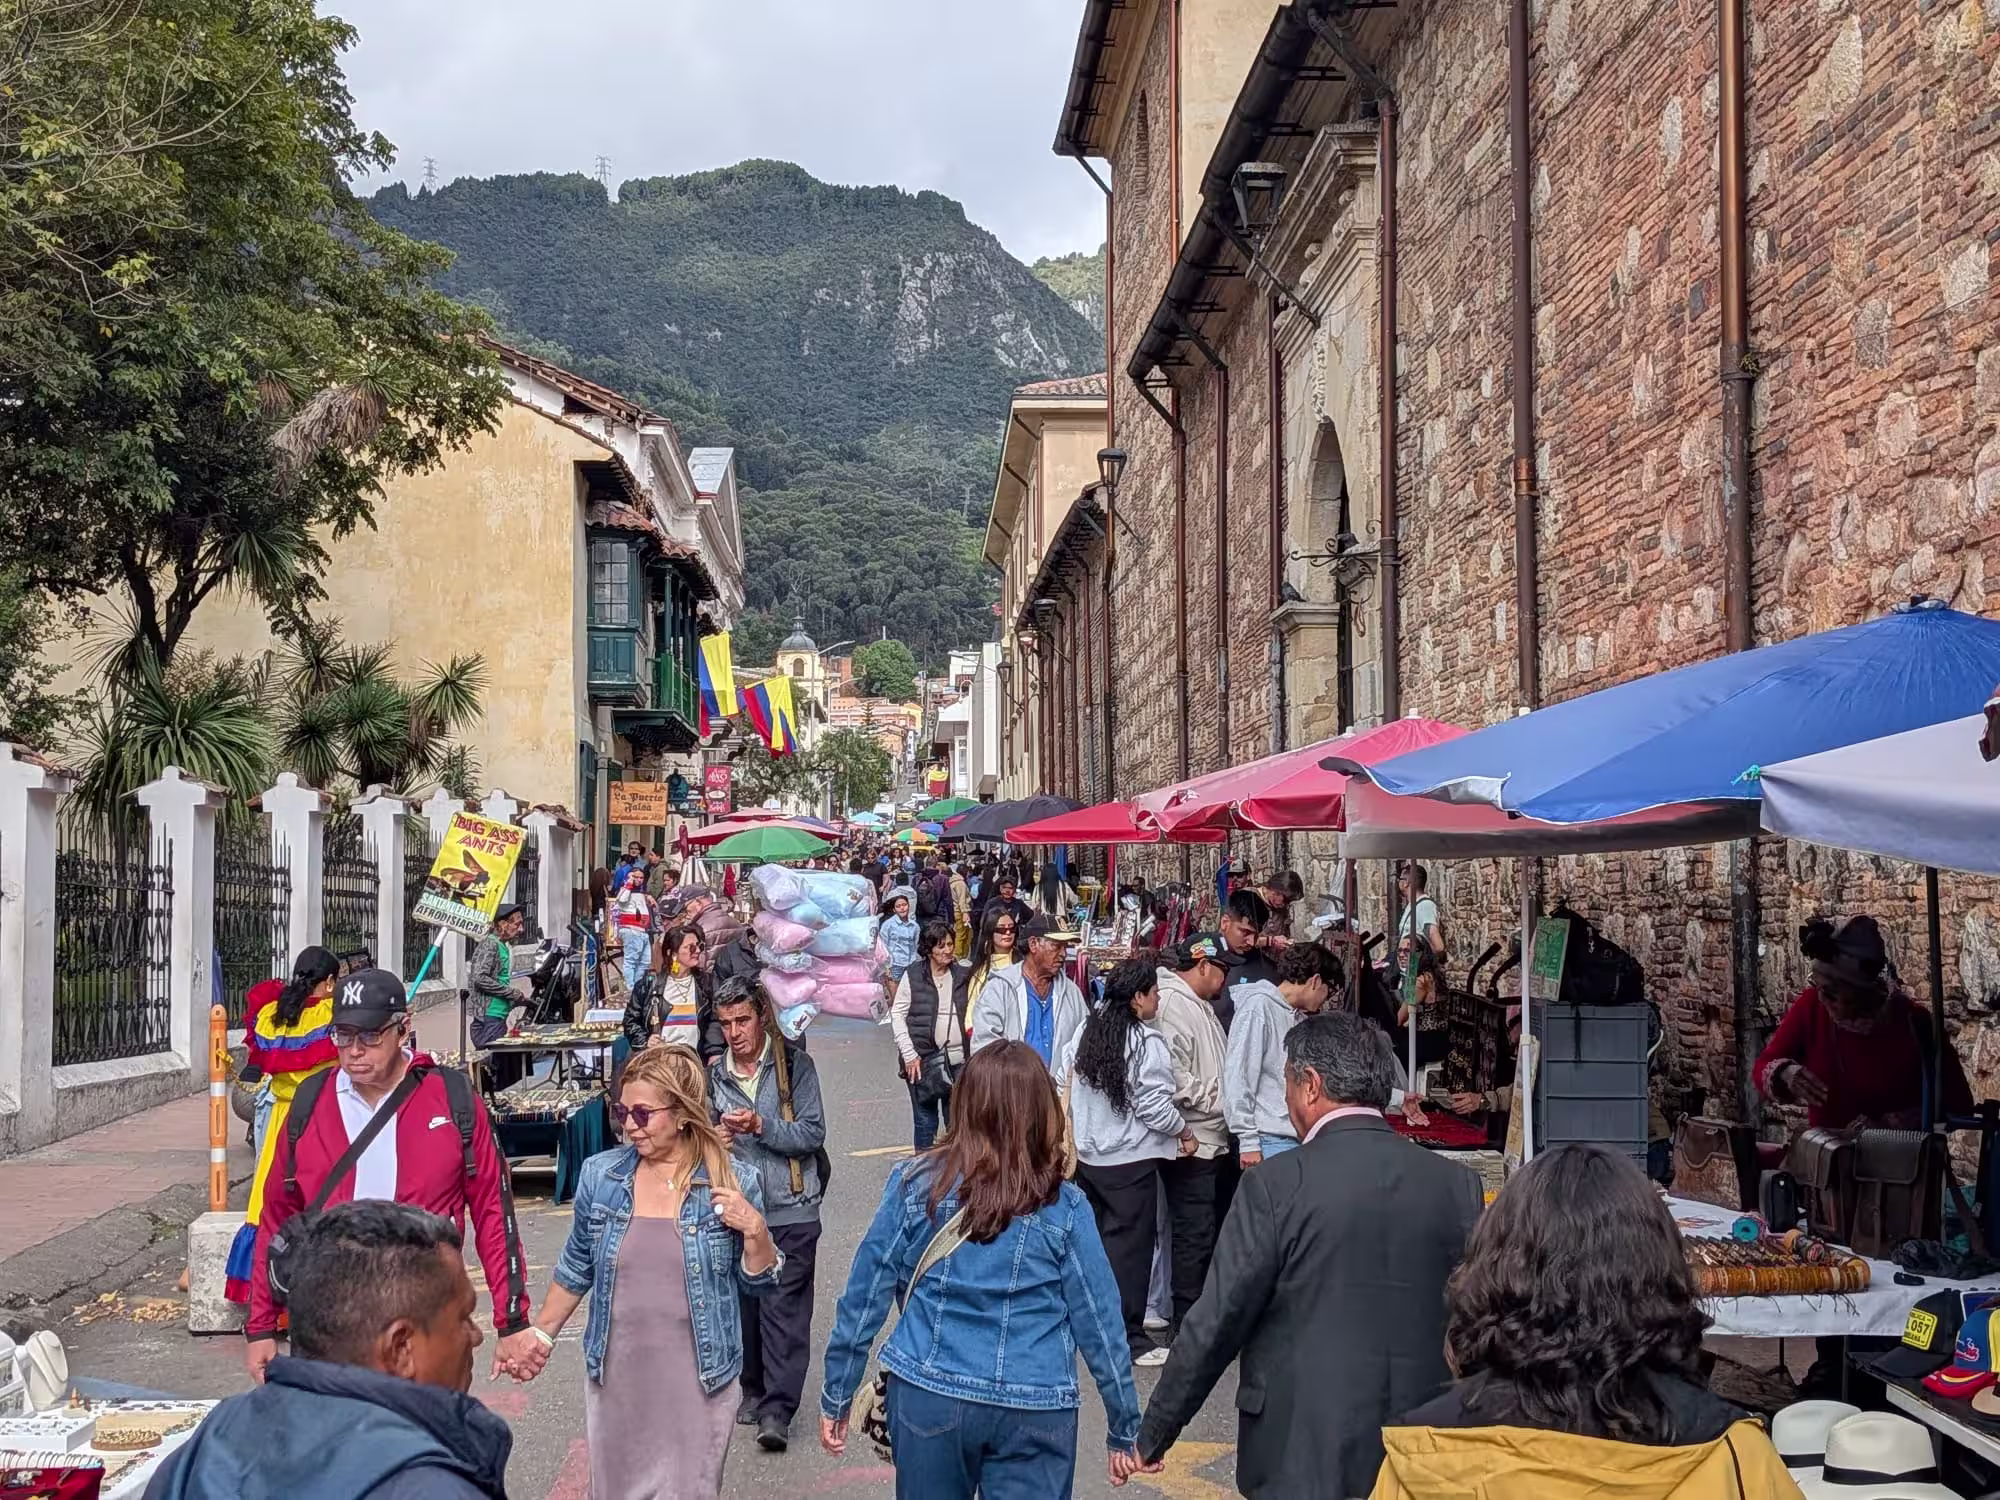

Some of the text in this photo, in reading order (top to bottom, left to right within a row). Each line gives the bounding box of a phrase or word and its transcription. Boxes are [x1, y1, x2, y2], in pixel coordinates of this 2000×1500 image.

[453, 815, 520, 845] BIG ASS
[456, 833, 507, 857] ANTS
[415, 904, 485, 935] AFRODISIACAS
[341, 980, 365, 1006] NY
